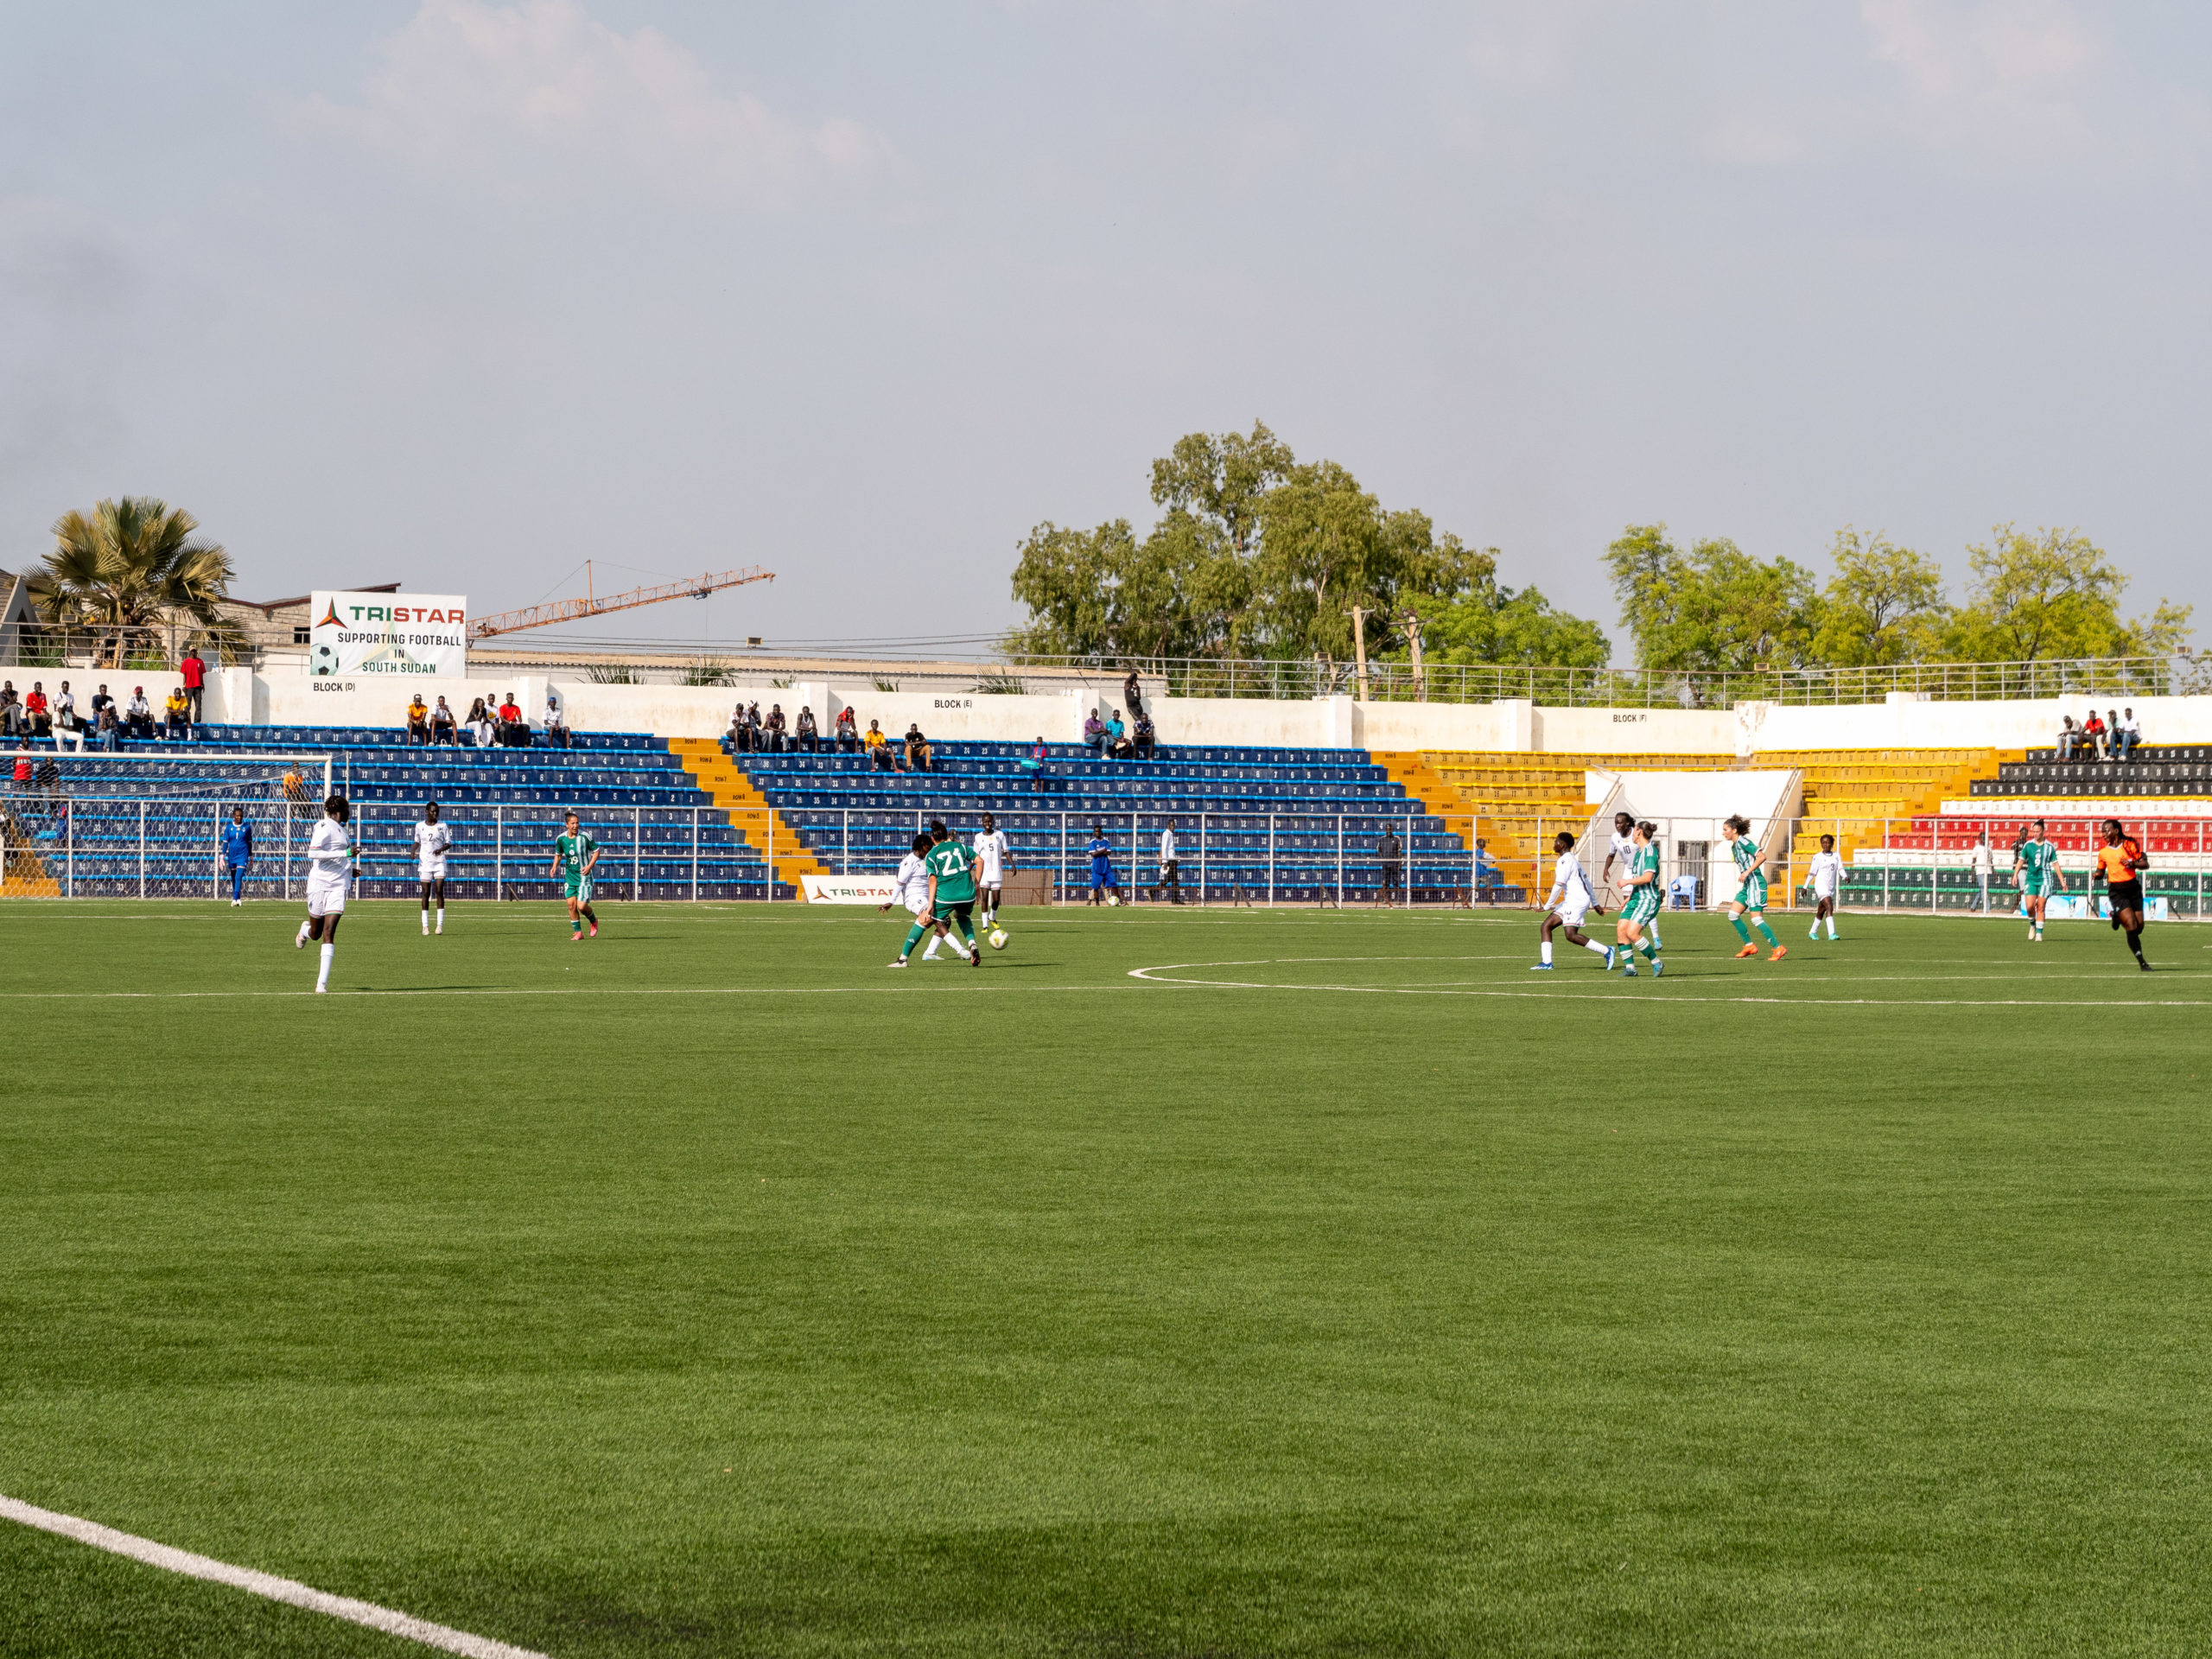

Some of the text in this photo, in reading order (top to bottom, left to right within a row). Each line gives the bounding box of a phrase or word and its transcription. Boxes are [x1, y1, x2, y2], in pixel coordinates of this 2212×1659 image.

[349, 606, 465, 624] TRISTAR
[338, 632, 461, 646] SUPPORTING FOOTBALL
[394, 649, 404, 658] IN
[362, 662, 436, 674] SOUTH SUDAN
[313, 682, 355, 692] BLOCK (D)
[934, 700, 972, 708] BLOCK (E)
[213, 730, 220, 738] 23
[232, 730, 239, 739] 22
[274, 732, 281, 740] 20
[332, 733, 339, 742] 17
[372, 734, 379, 742] 15
[395, 734, 401, 743] 14
[412, 734, 419, 743] 13
[586, 738, 591, 746] 4
[624, 739, 629, 747] 2
[645, 740, 648, 748] 1
[387, 753, 394, 761] 15
[408, 753, 415, 761] 14
[426, 753, 433, 761] 13
[445, 753, 452, 762] 12
[465, 753, 472, 762] 11
[544, 755, 549, 763] 7
[582, 756, 587, 764] 5
[603, 756, 607, 765] 4
[620, 757, 624, 765] 3
[639, 758, 643, 766] 2
[659, 757, 663, 765] 1
[421, 771, 428, 780] 14
[442, 771, 448, 779] 13
[460, 772, 467, 780] 12
[479, 772, 486, 781] 11
[500, 773, 507, 781] 10
[559, 774, 564, 782] 7
[597, 774, 602, 782] 5
[616, 776, 620, 784] 4
[635, 776, 639, 784] 3
[674, 775, 678, 784] 1
[376, 789, 383, 797] 17
[417, 790, 423, 798] 15
[437, 790, 443, 798] 14
[455, 790, 462, 798] 13
[494, 791, 500, 799] 11
[574, 792, 579, 800] 7
[613, 792, 617, 800] 5
[631, 793, 636, 802] 4
[650, 794, 655, 802] 3
[670, 794, 675, 802] 2
[689, 795, 693, 803] 1
[428, 833, 433, 842] 2
[989, 843, 994, 852] 5
[1623, 845, 1631, 854] 10
[570, 856, 579, 865] 19
[936, 848, 968, 876] 21
[2035, 858, 2041, 867] 9
